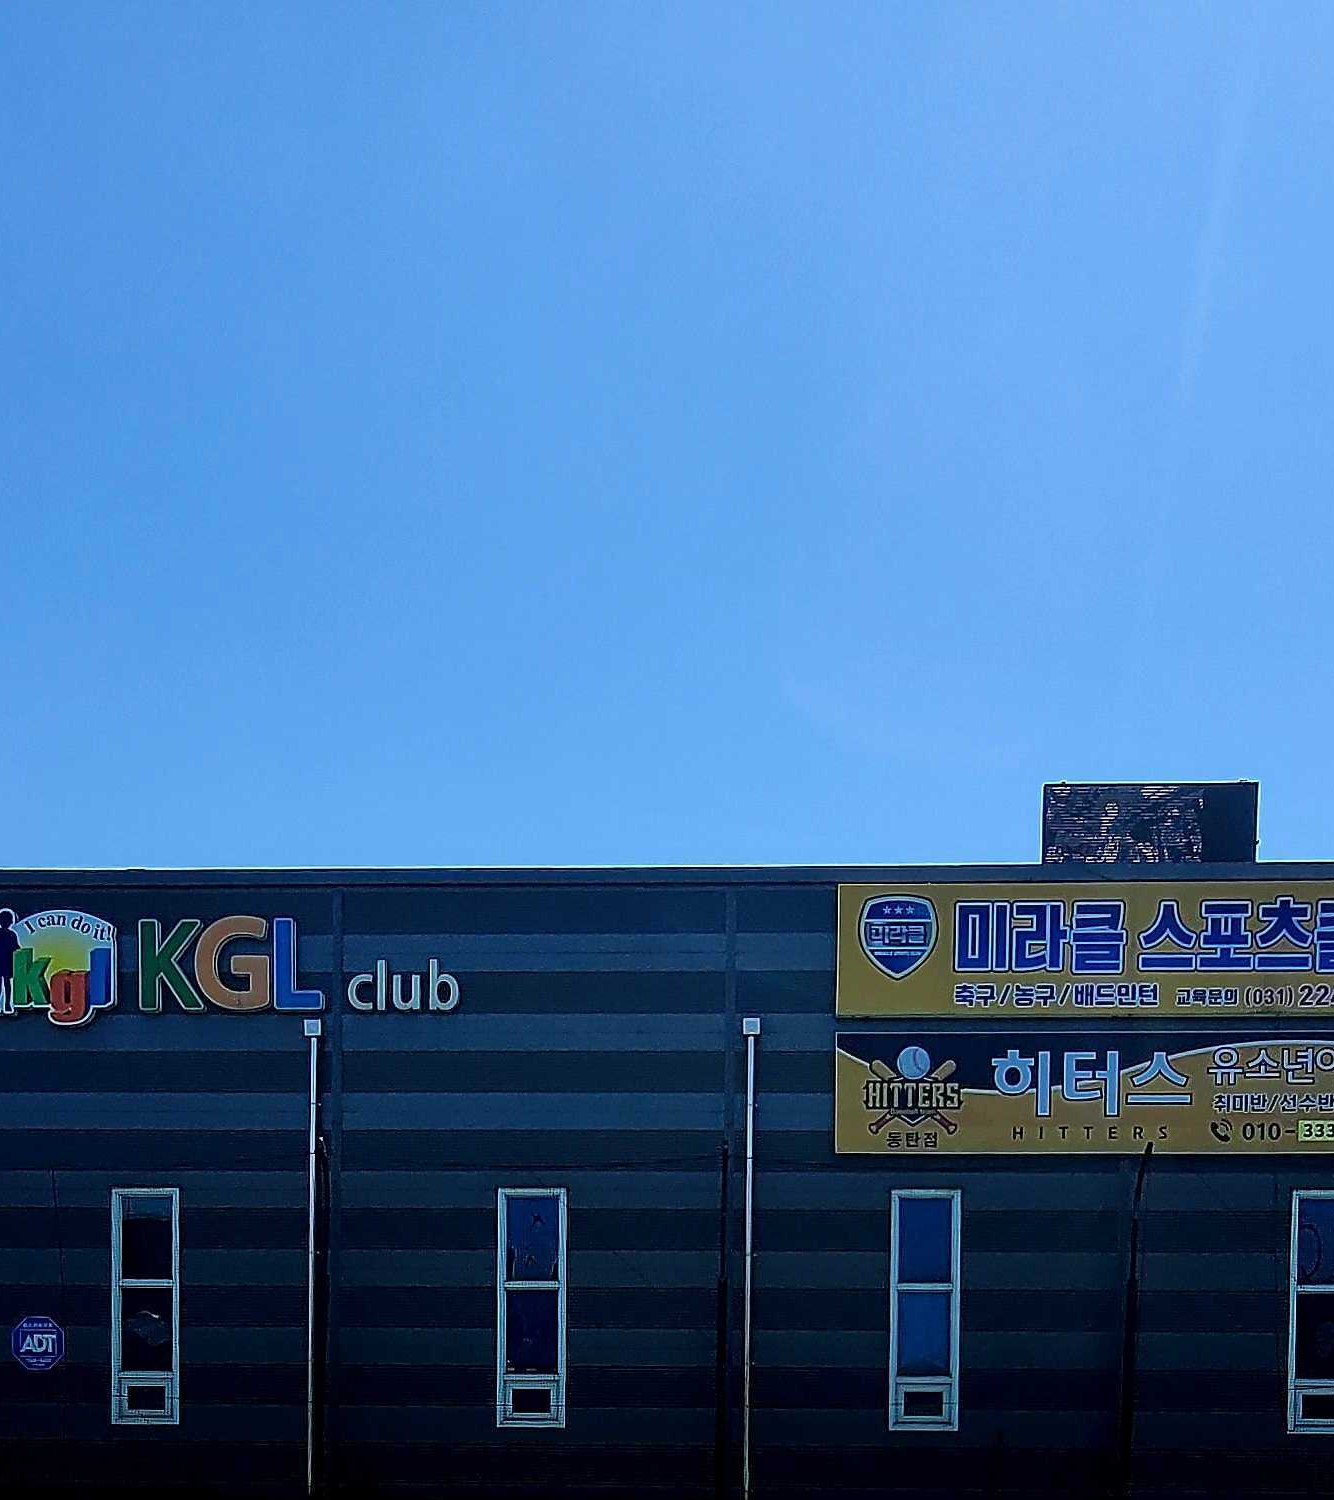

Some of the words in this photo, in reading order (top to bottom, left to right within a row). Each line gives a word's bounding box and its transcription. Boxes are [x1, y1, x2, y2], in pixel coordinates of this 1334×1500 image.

[24, 920, 36, 935] I
[38, 914, 66, 928] can
[71, 915, 92, 935] do
[92, 924, 113, 941] it!
[870, 924, 926, 945] 미라클
[953, 900, 1127, 976] 미라클
[138, 915, 324, 1012] KGL
[347, 958, 460, 1012] club
[13, 947, 112, 1024] kgl
[954, 983, 1159, 1007] 축구/농구/배드민턴
[1175, 987, 1238, 1007] 교육문의
[1244, 986, 1294, 1008] (031)
[867, 1082, 959, 1109] HITTERS
[990, 1049, 1193, 1118] 히터스
[886, 1131, 938, 1149] 동탄점
[1012, 1126, 1168, 1141] HITTERS
[19, 1334, 57, 1353] ADT
